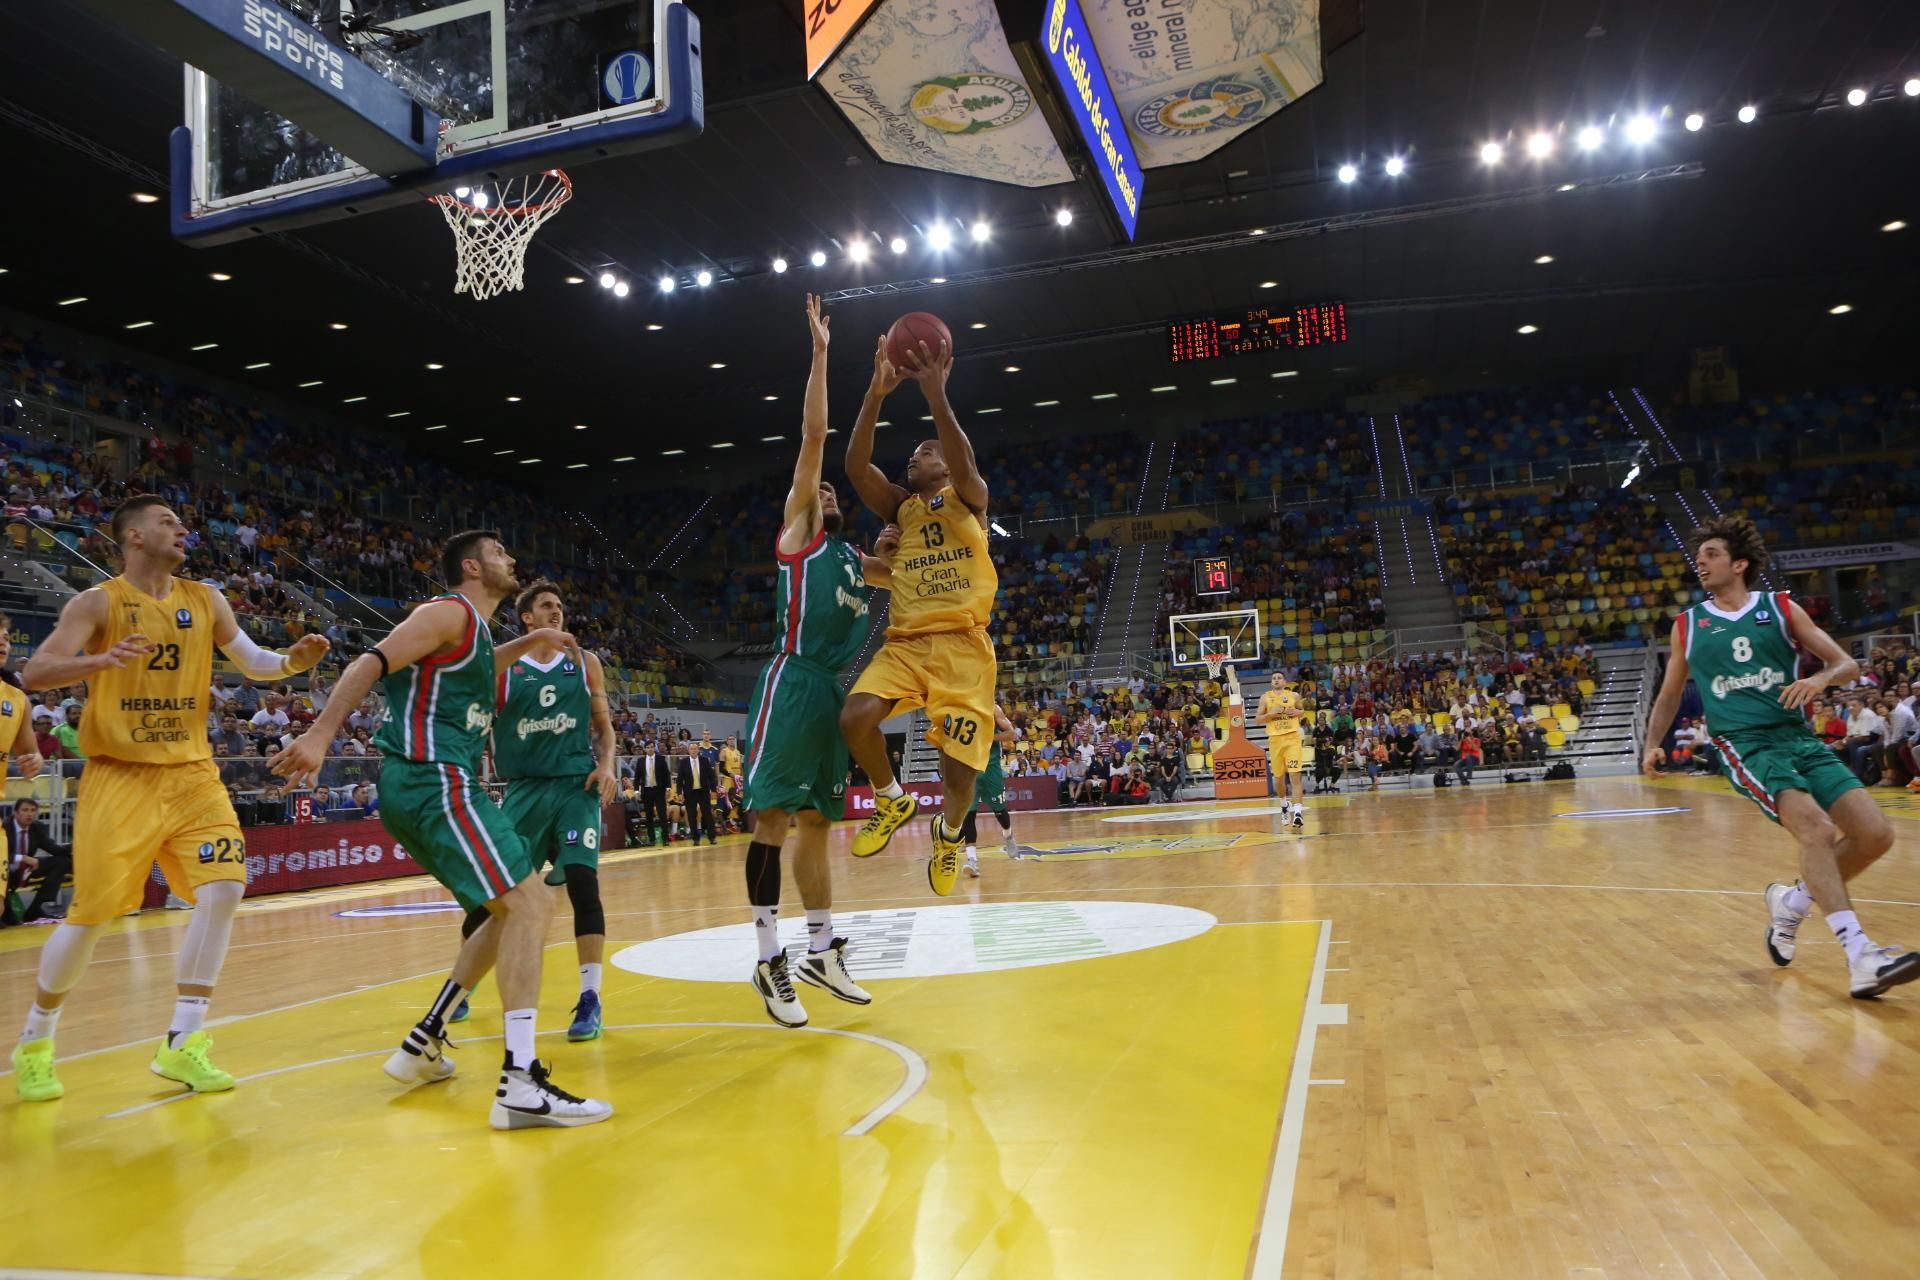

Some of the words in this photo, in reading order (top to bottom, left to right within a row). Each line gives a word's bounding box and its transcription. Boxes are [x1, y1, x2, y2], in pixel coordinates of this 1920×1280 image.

[243, 11, 344, 90] Sports
[1128, 21, 1158, 59] elige
[1157, 12, 1193, 71] mineral
[968, 76, 1018, 92] AGUA
[1062, 27, 1093, 111] Cabildo
[1091, 97, 1103, 135] de
[1100, 118, 1117, 171] Gran
[1115, 154, 1137, 218] Canaria
[1248, 309, 1268, 321] 3:49
[920, 522, 944, 549] 13
[904, 547, 974, 572] HERBALIFE
[1205, 561, 1227, 572] 3:49
[921, 567, 958, 582] Gran
[1209, 571, 1225, 588] 19
[916, 576, 970, 597] Canaria
[148, 643, 180, 671] 23
[1732, 636, 1753, 662] 8
[121, 698, 196, 711] HERBALFE
[539, 685, 557, 707] 6
[142, 713, 183, 729] Gran
[952, 717, 977, 746] 13
[1215, 759, 1265, 771] SPORT
[1215, 769, 1267, 780] ZONE
[301, 800, 311, 816] 5
[583, 827, 597, 849] 6
[216, 838, 245, 864] 23
[246, 839, 384, 884] promiso
